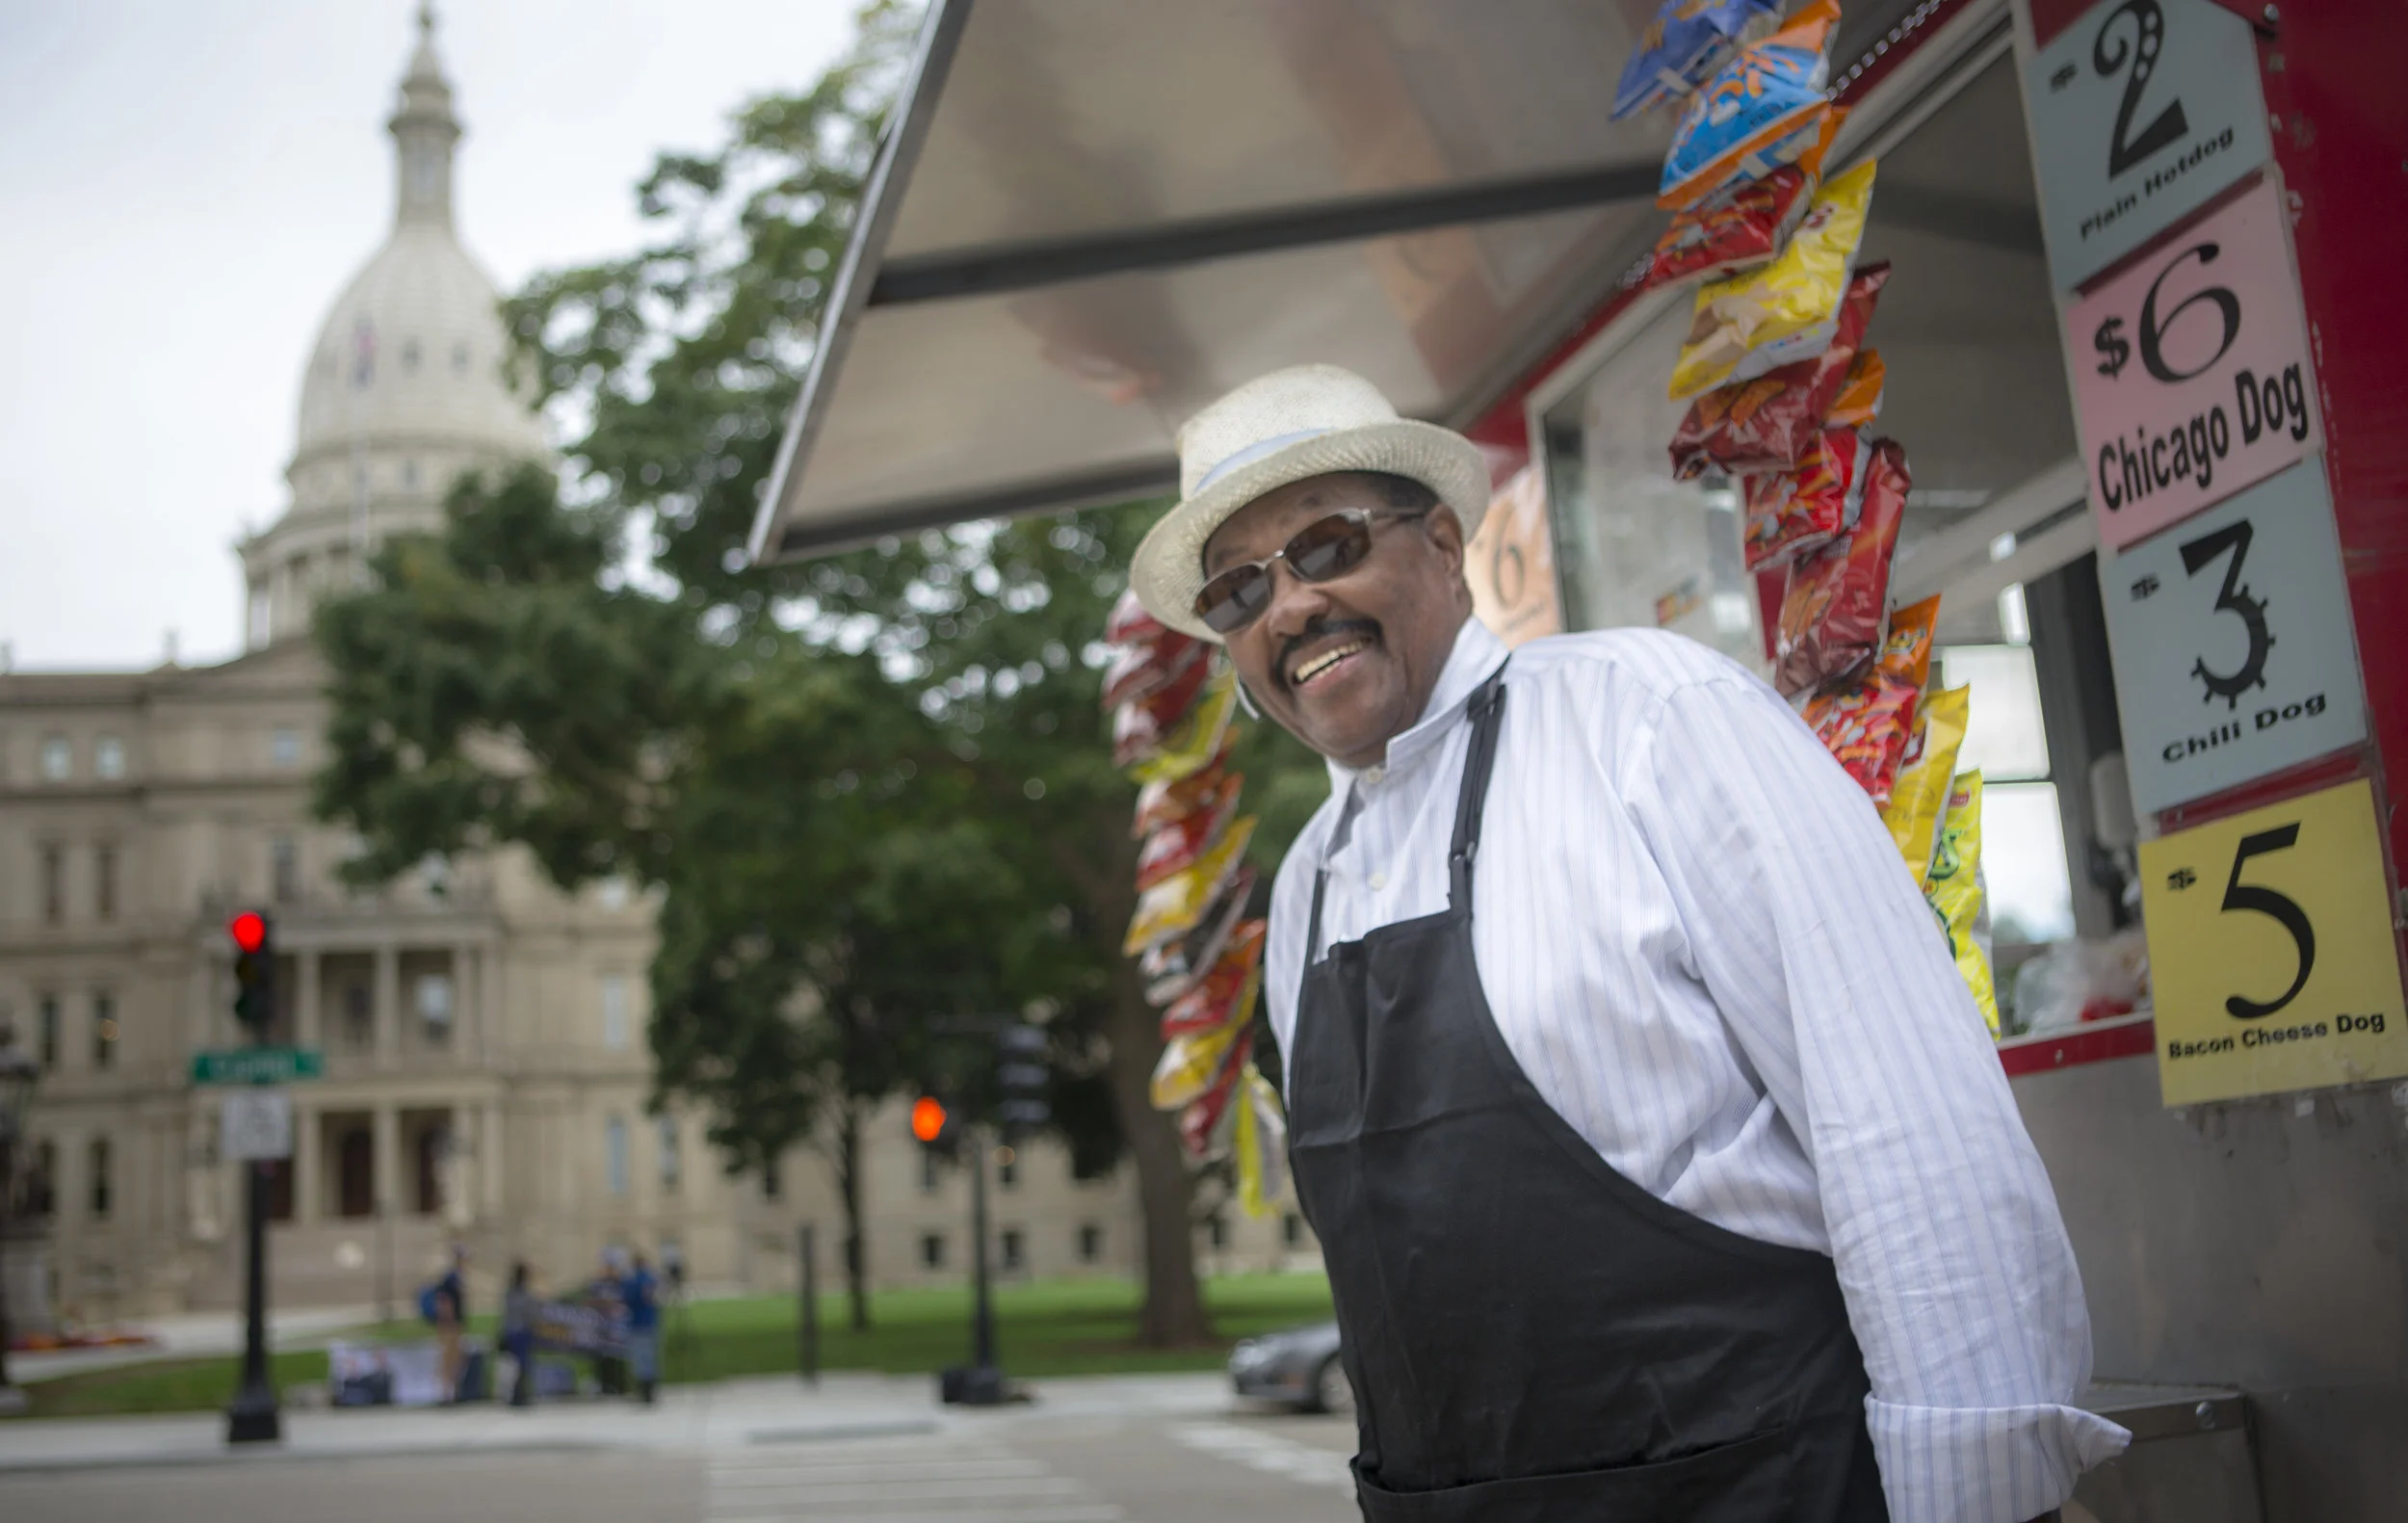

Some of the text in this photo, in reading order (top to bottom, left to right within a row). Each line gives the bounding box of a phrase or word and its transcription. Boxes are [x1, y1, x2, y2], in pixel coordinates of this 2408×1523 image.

[2081, 126, 2235, 240] Plain Hotdog
[2094, 243, 2240, 383] $6
[2099, 361, 2308, 511] Chicago Dog
[2162, 691, 2327, 763] Chili Dog
[2169, 1012, 2386, 1060] Bacon Cheese Dog
